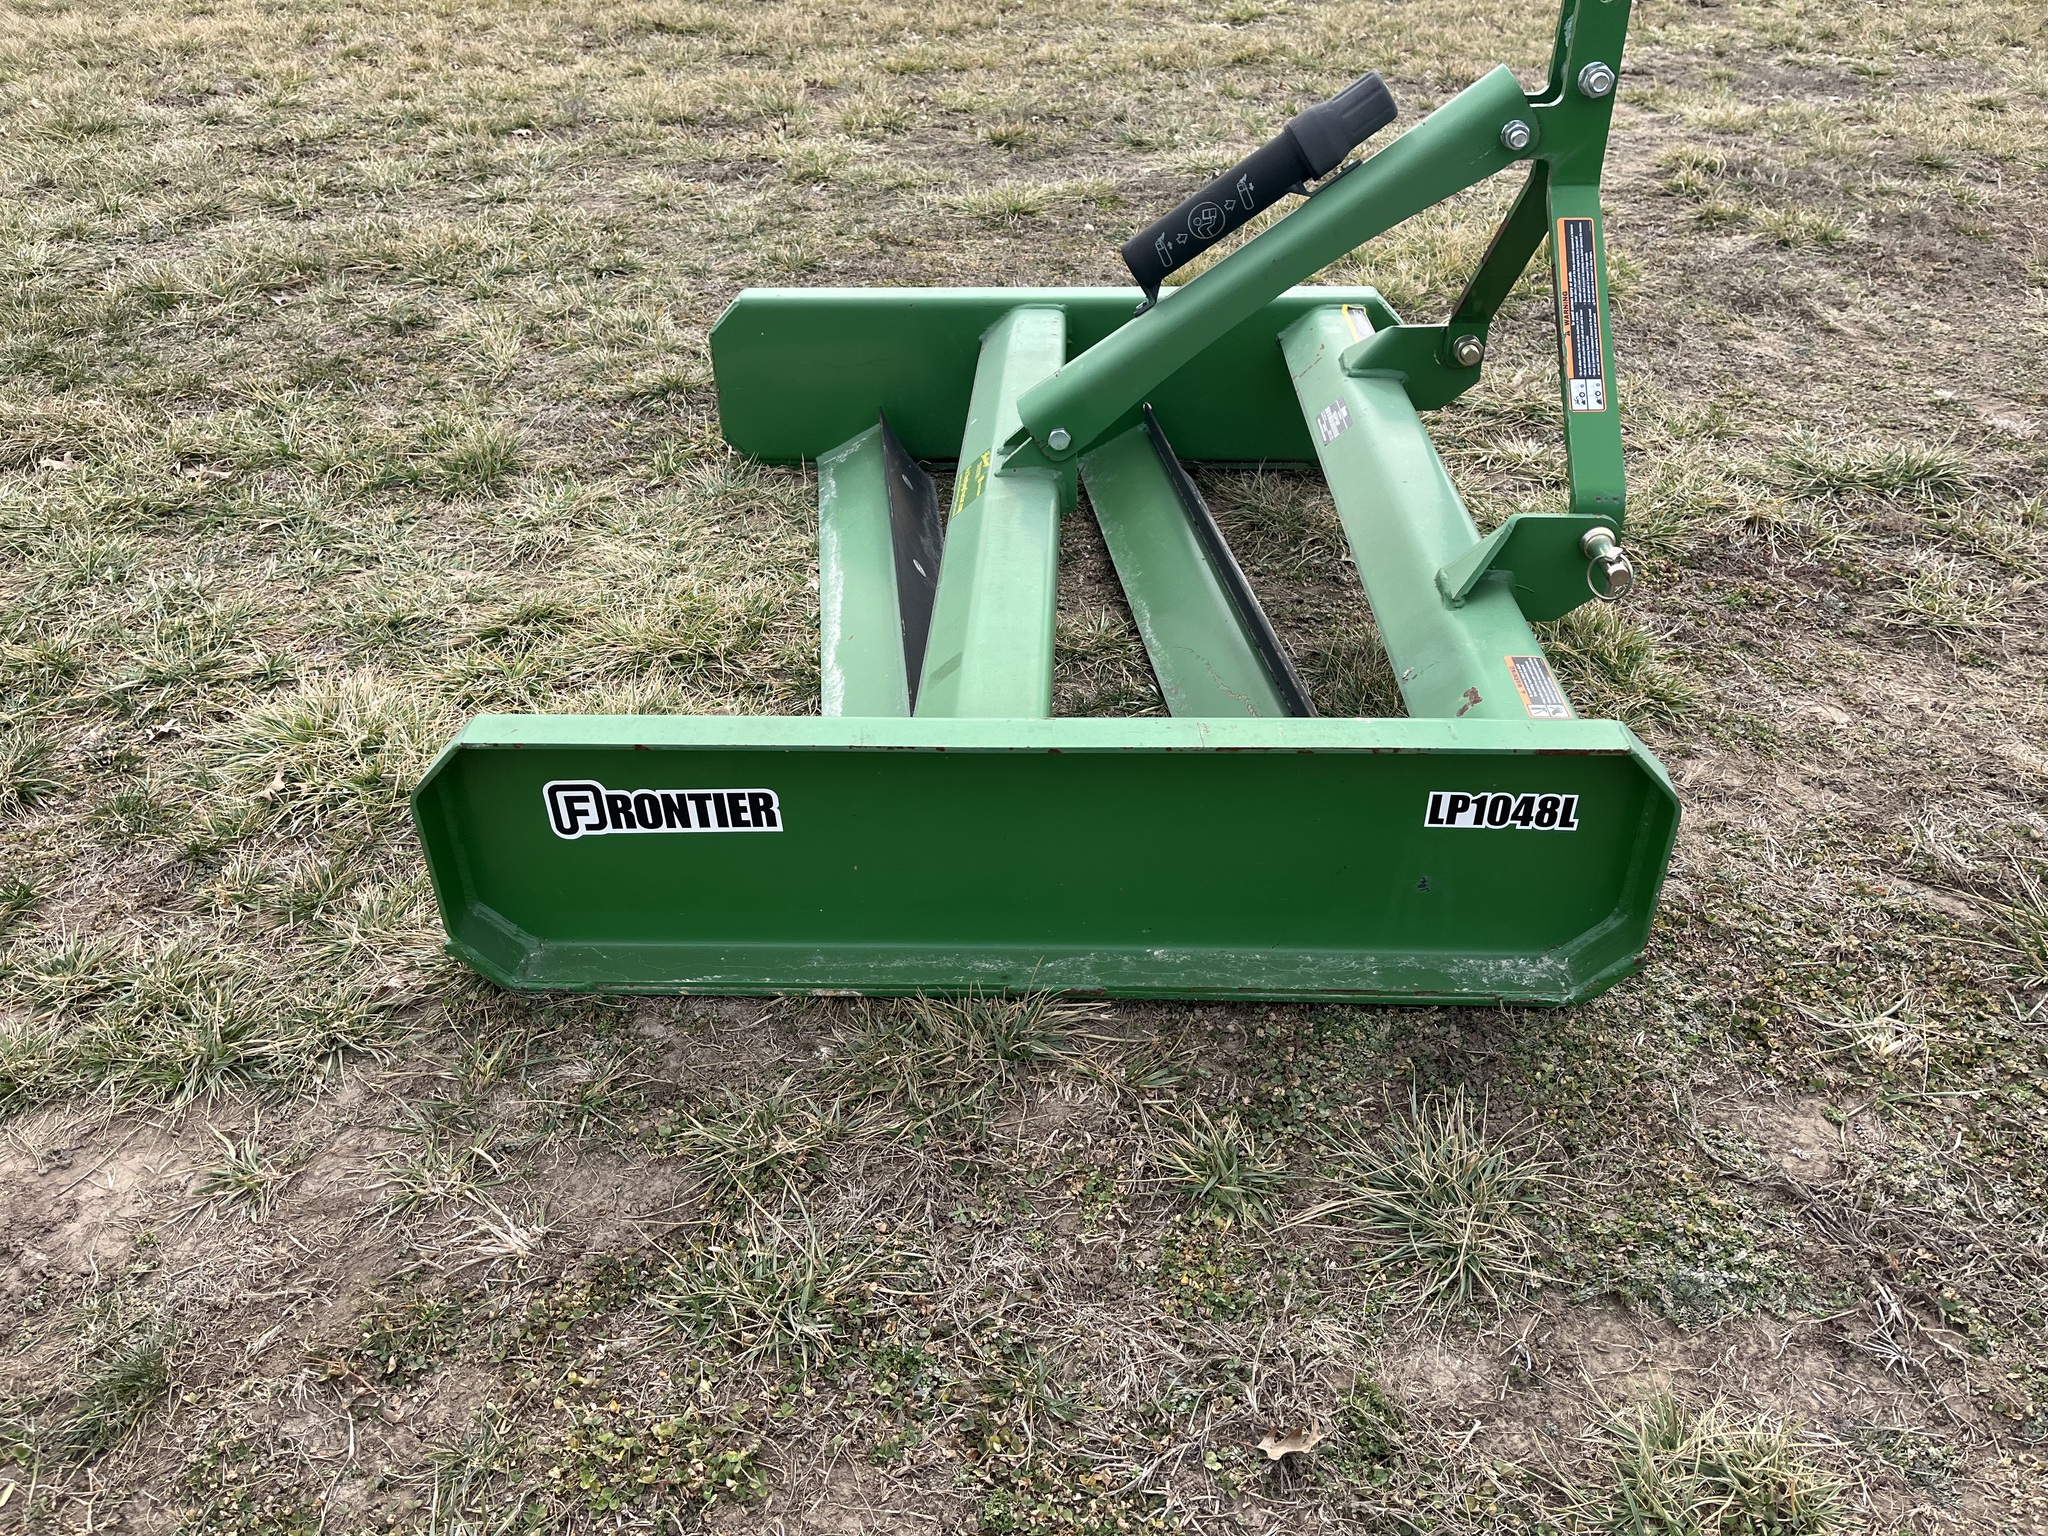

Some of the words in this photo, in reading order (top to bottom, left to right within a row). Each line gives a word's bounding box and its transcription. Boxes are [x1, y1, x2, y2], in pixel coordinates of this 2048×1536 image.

[1562, 290, 1570, 326] WARNING
[546, 784, 778, 836] FRONTIER
[1427, 793, 1576, 828] LP1048L
